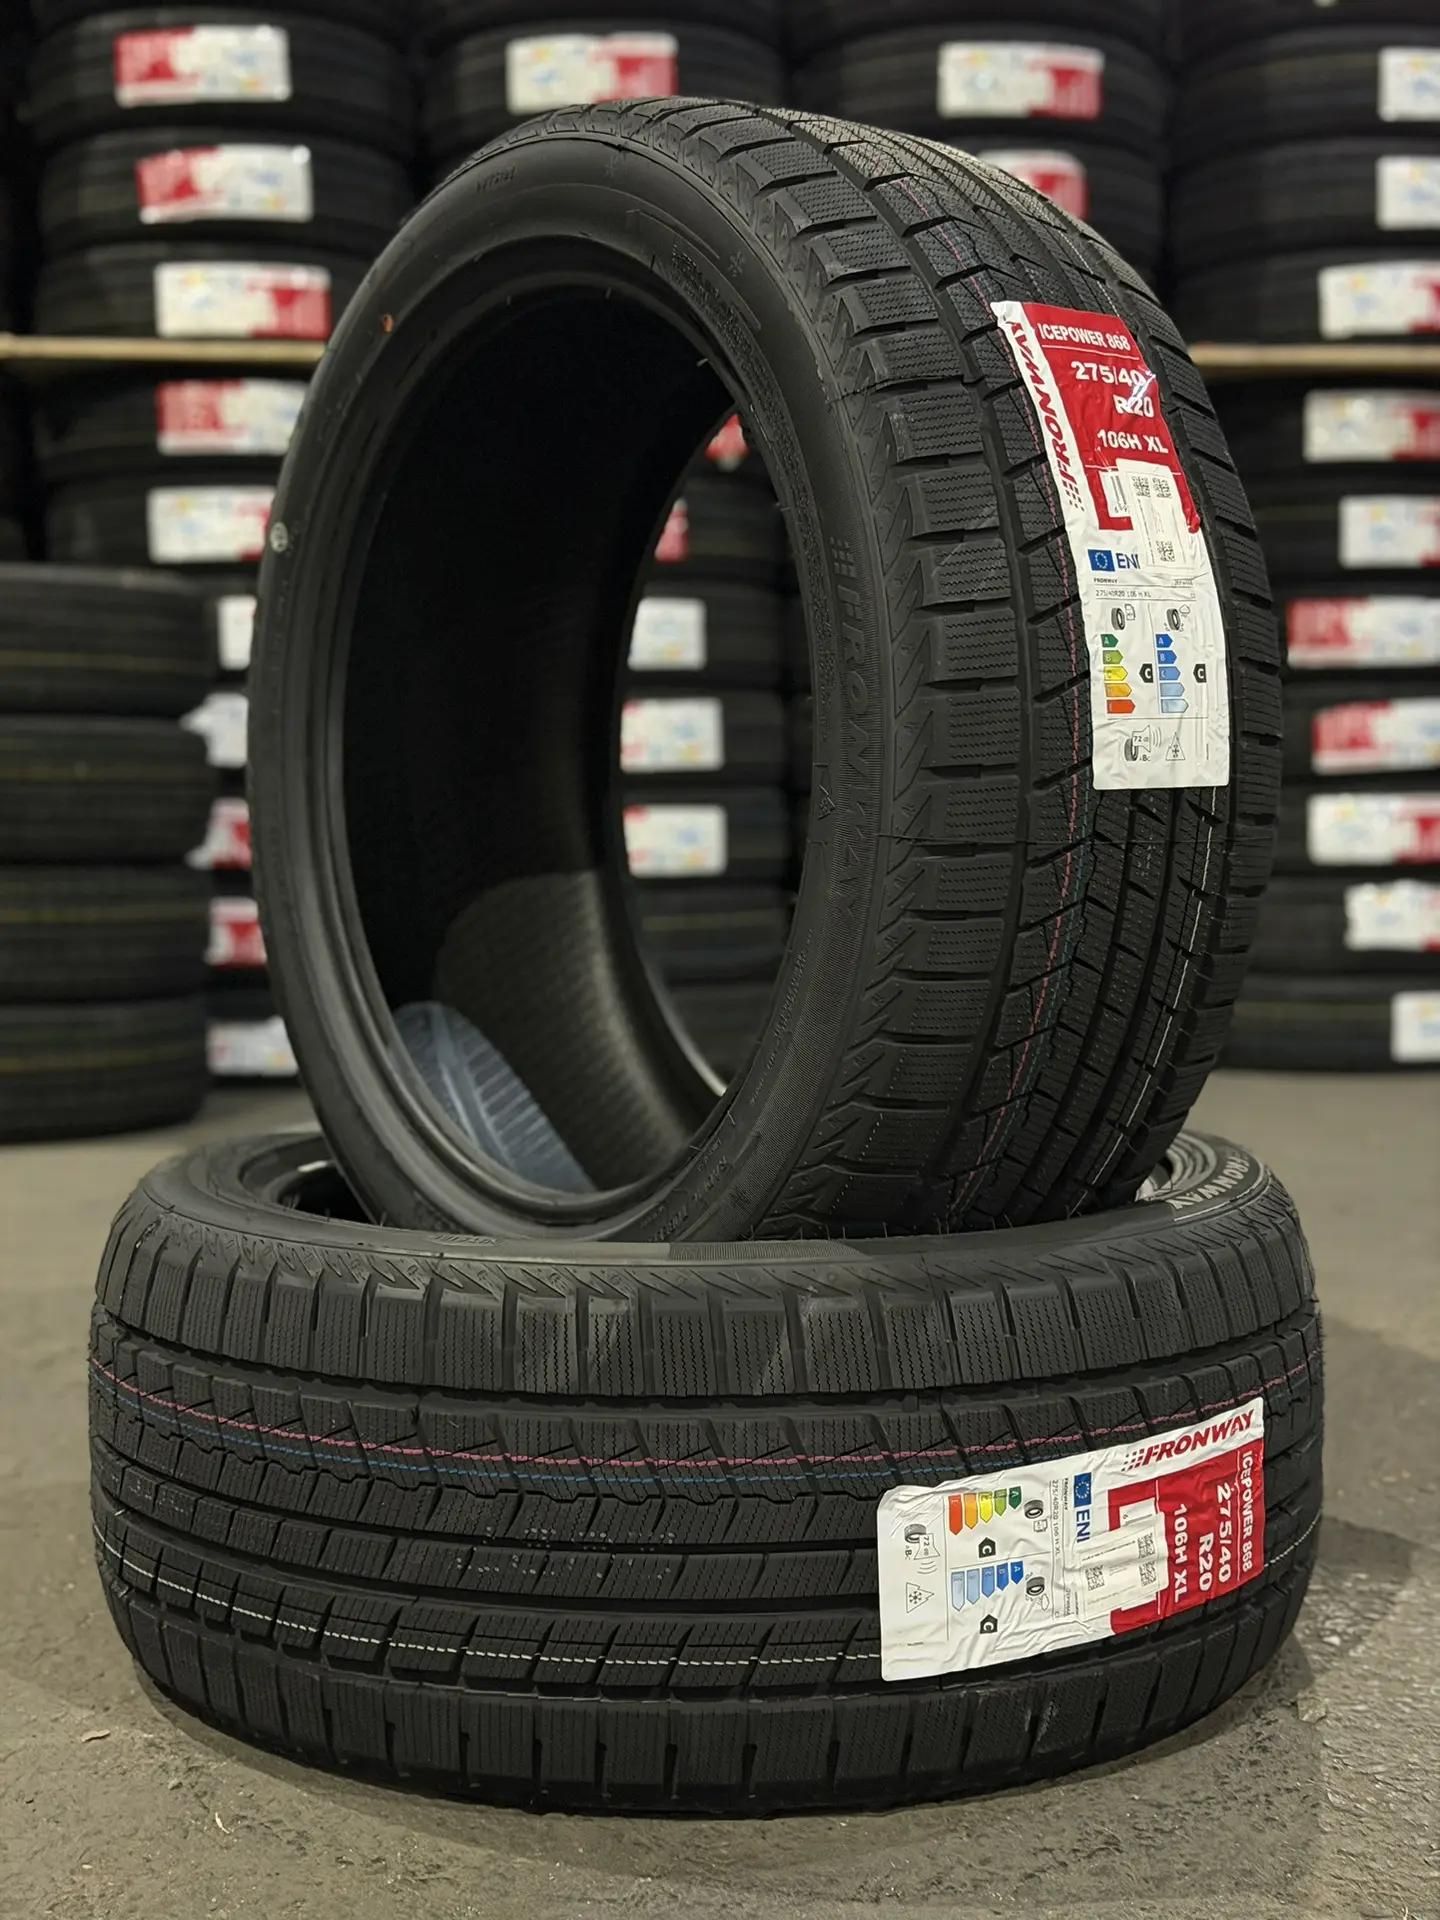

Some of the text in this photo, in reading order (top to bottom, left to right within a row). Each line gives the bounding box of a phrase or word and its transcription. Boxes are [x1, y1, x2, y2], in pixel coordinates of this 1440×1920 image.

[1038, 323, 1131, 352] ICEPOWER 868
[1070, 361, 1144, 388] 275/40
[1004, 320, 1078, 490] FRONWAY
[1112, 395, 1154, 419] R20
[1096, 430, 1169, 454] 106H XL
[1144, 667, 1152, 680] C
[1197, 668, 1204, 680] C
[1133, 735, 1143, 743] 72
[1165, 1155, 1251, 1210] FRONWAY
[1141, 1409, 1254, 1466] FRONWAY
[1241, 1450, 1254, 1573] ICEPOWER 868
[923, 1536, 929, 1547] 72
[1216, 1484, 1233, 1583] 275/40
[983, 1545, 993, 1554] C
[1172, 1503, 1188, 1603] 106H XL
[1198, 1536, 1215, 1591] R20
[984, 1622, 994, 1631] C
